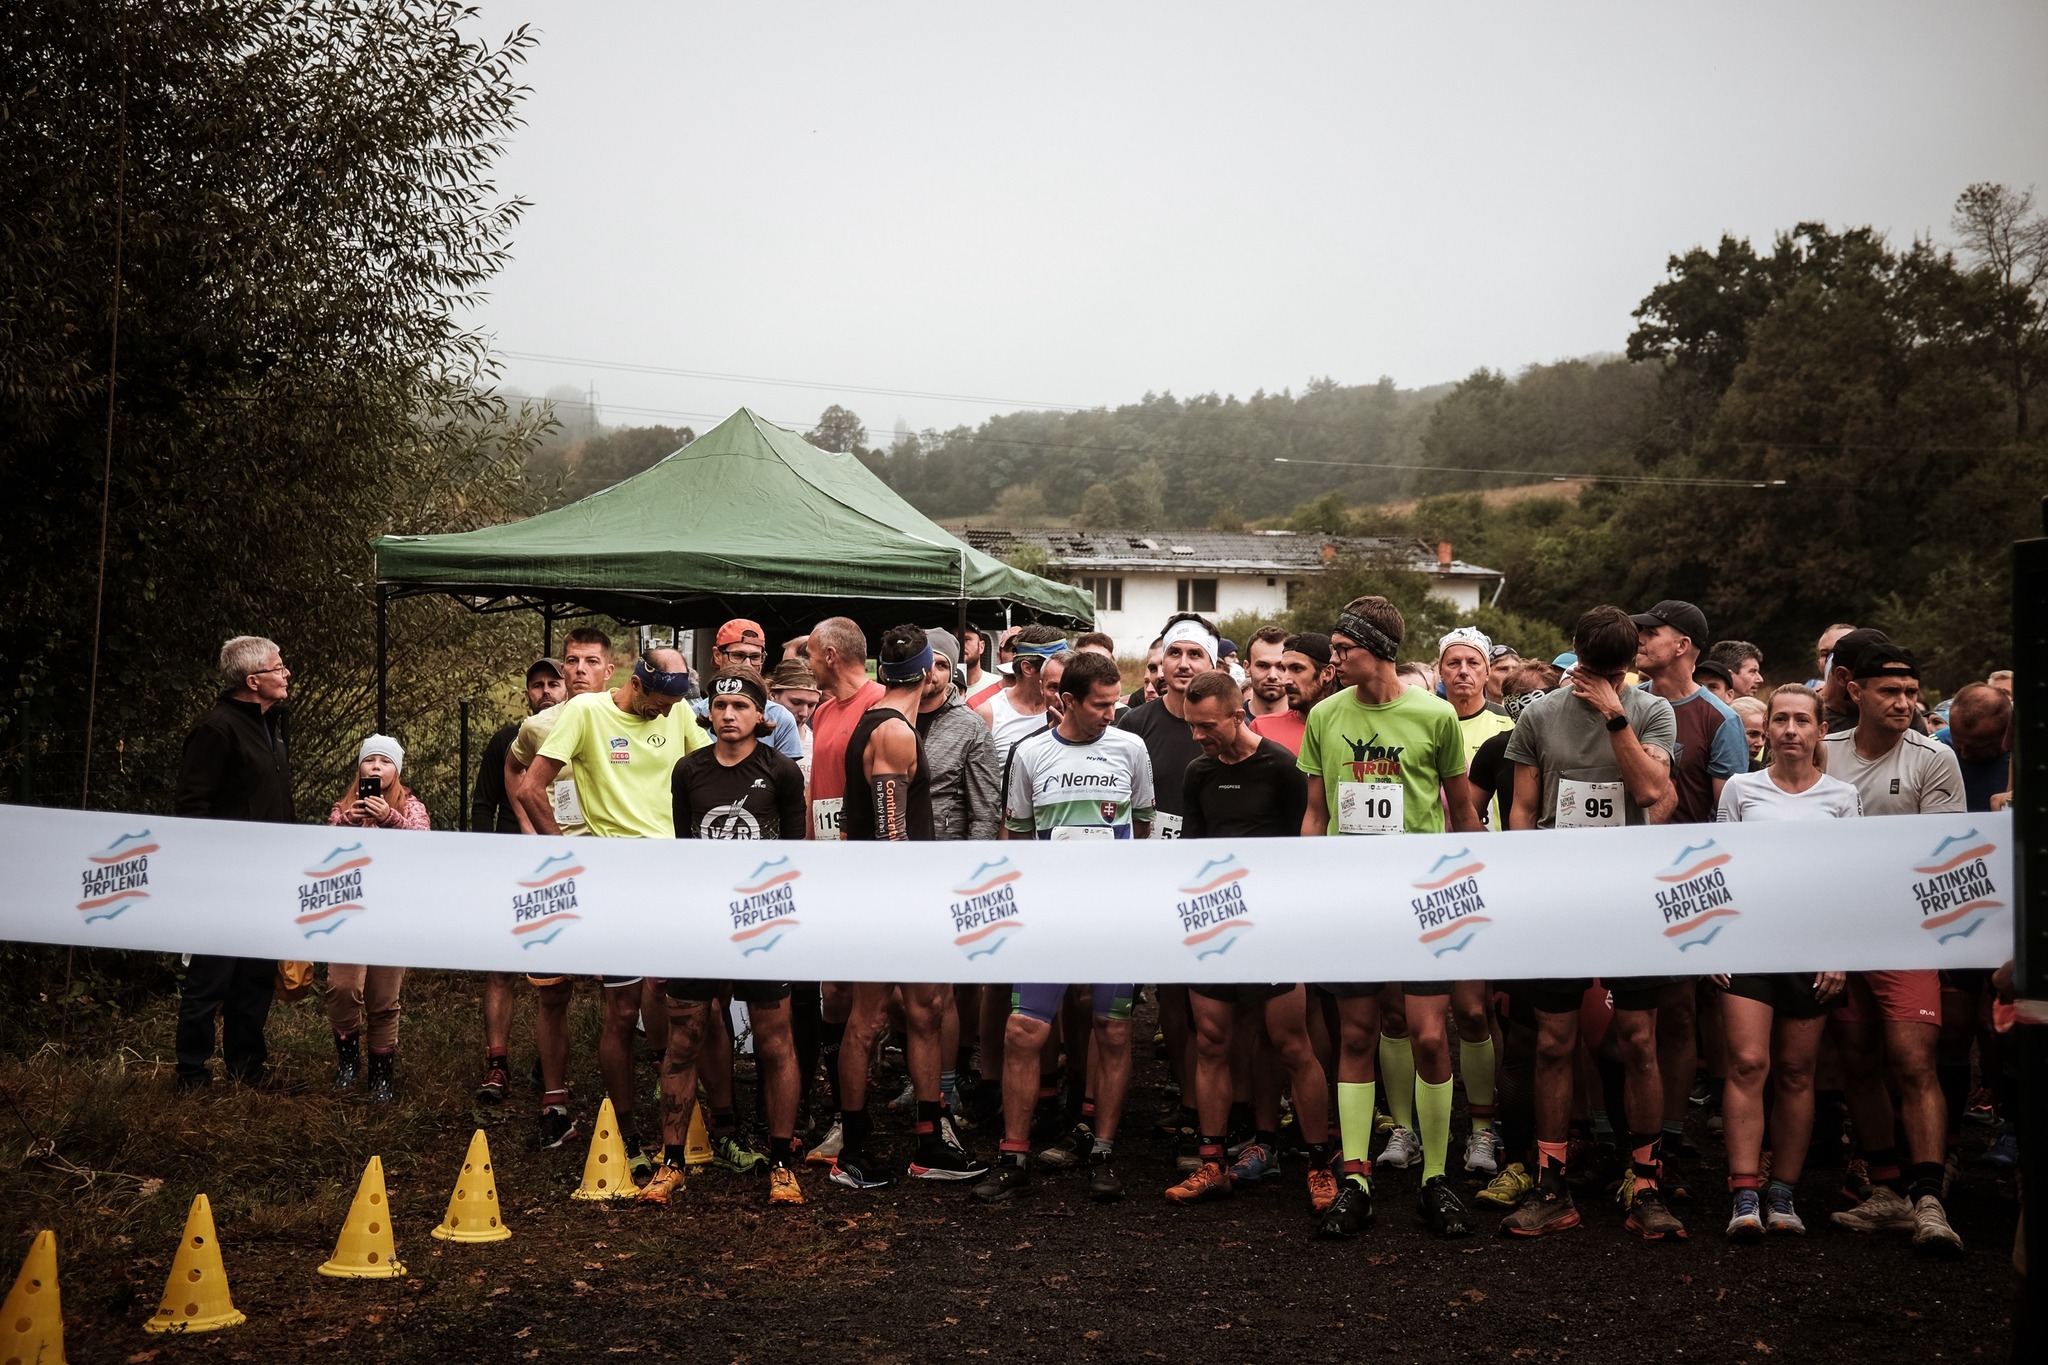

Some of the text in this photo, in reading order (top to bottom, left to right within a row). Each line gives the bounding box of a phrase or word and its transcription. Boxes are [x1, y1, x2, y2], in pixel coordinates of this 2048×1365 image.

[1061, 772, 1119, 788] Nemak
[1365, 762, 1400, 775] RUN
[877, 781, 882, 792] na
[819, 811, 840, 830] 119
[1365, 798, 1392, 818] 10
[1585, 798, 1613, 818] 95
[81, 855, 148, 885] SLATINSKÔ
[83, 872, 149, 898] PRPLENIA
[298, 868, 362, 899] SLATINSKÔ
[1912, 858, 1988, 901] SLATINSKÔ
[300, 886, 363, 912] PRPLENIA
[512, 877, 576, 910] SLATINSKÔ
[729, 882, 793, 916] SLATINSKÔ
[950, 883, 1015, 918] SLATINSKÔ
[1176, 881, 1242, 918] SLATINSKÔ
[1411, 875, 1479, 915] SLATINSKÔ
[1654, 867, 1725, 909] SLATINSKÔ
[1920, 877, 1996, 916] PRPLENIA
[515, 895, 578, 922] PRPLENIA
[733, 900, 796, 929] PRPLENIA
[955, 901, 1019, 932] PRPLENIA
[1183, 899, 1248, 932] PRPLENIA
[1418, 894, 1486, 930] PRPLENIA
[1662, 887, 1733, 923] PRPLENIA
